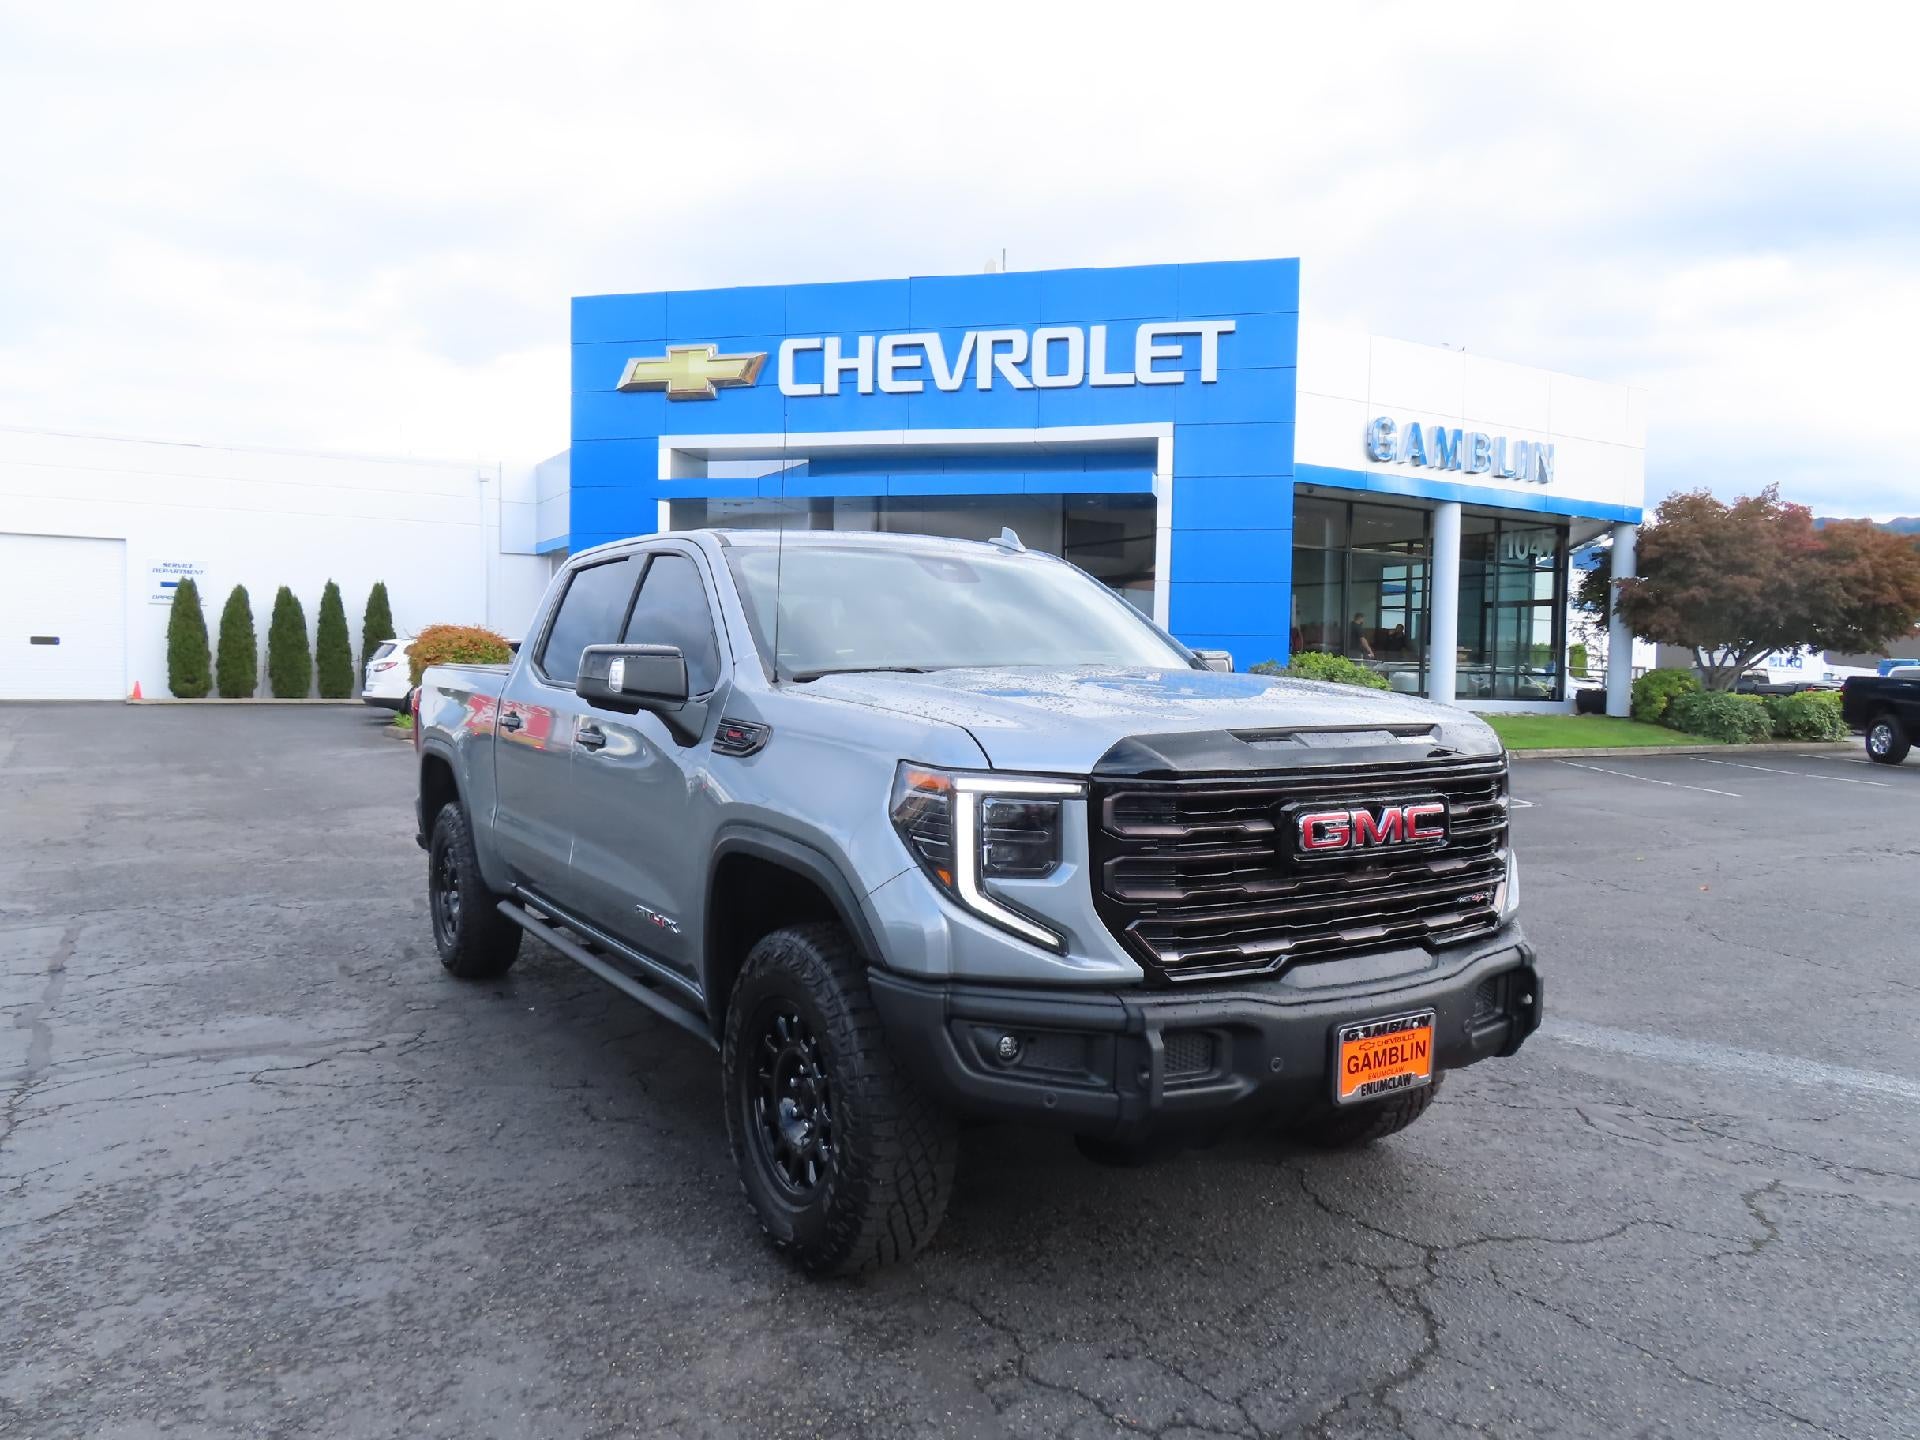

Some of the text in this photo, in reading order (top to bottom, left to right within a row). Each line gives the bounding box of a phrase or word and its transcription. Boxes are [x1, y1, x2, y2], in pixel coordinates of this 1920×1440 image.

[778, 320, 1236, 396] CHEVROLET
[1368, 416, 1554, 483] GAMBLIN
[1298, 803, 1445, 851] GMC
[1343, 1015, 1432, 1041] GAMBLIN
[1376, 1033, 1416, 1047] CHEVROLET
[1346, 1039, 1427, 1075] GAMBLIN
[1361, 1073, 1412, 1096] ENUMCLAW
[1368, 1066, 1405, 1080] ENUMCLAW
